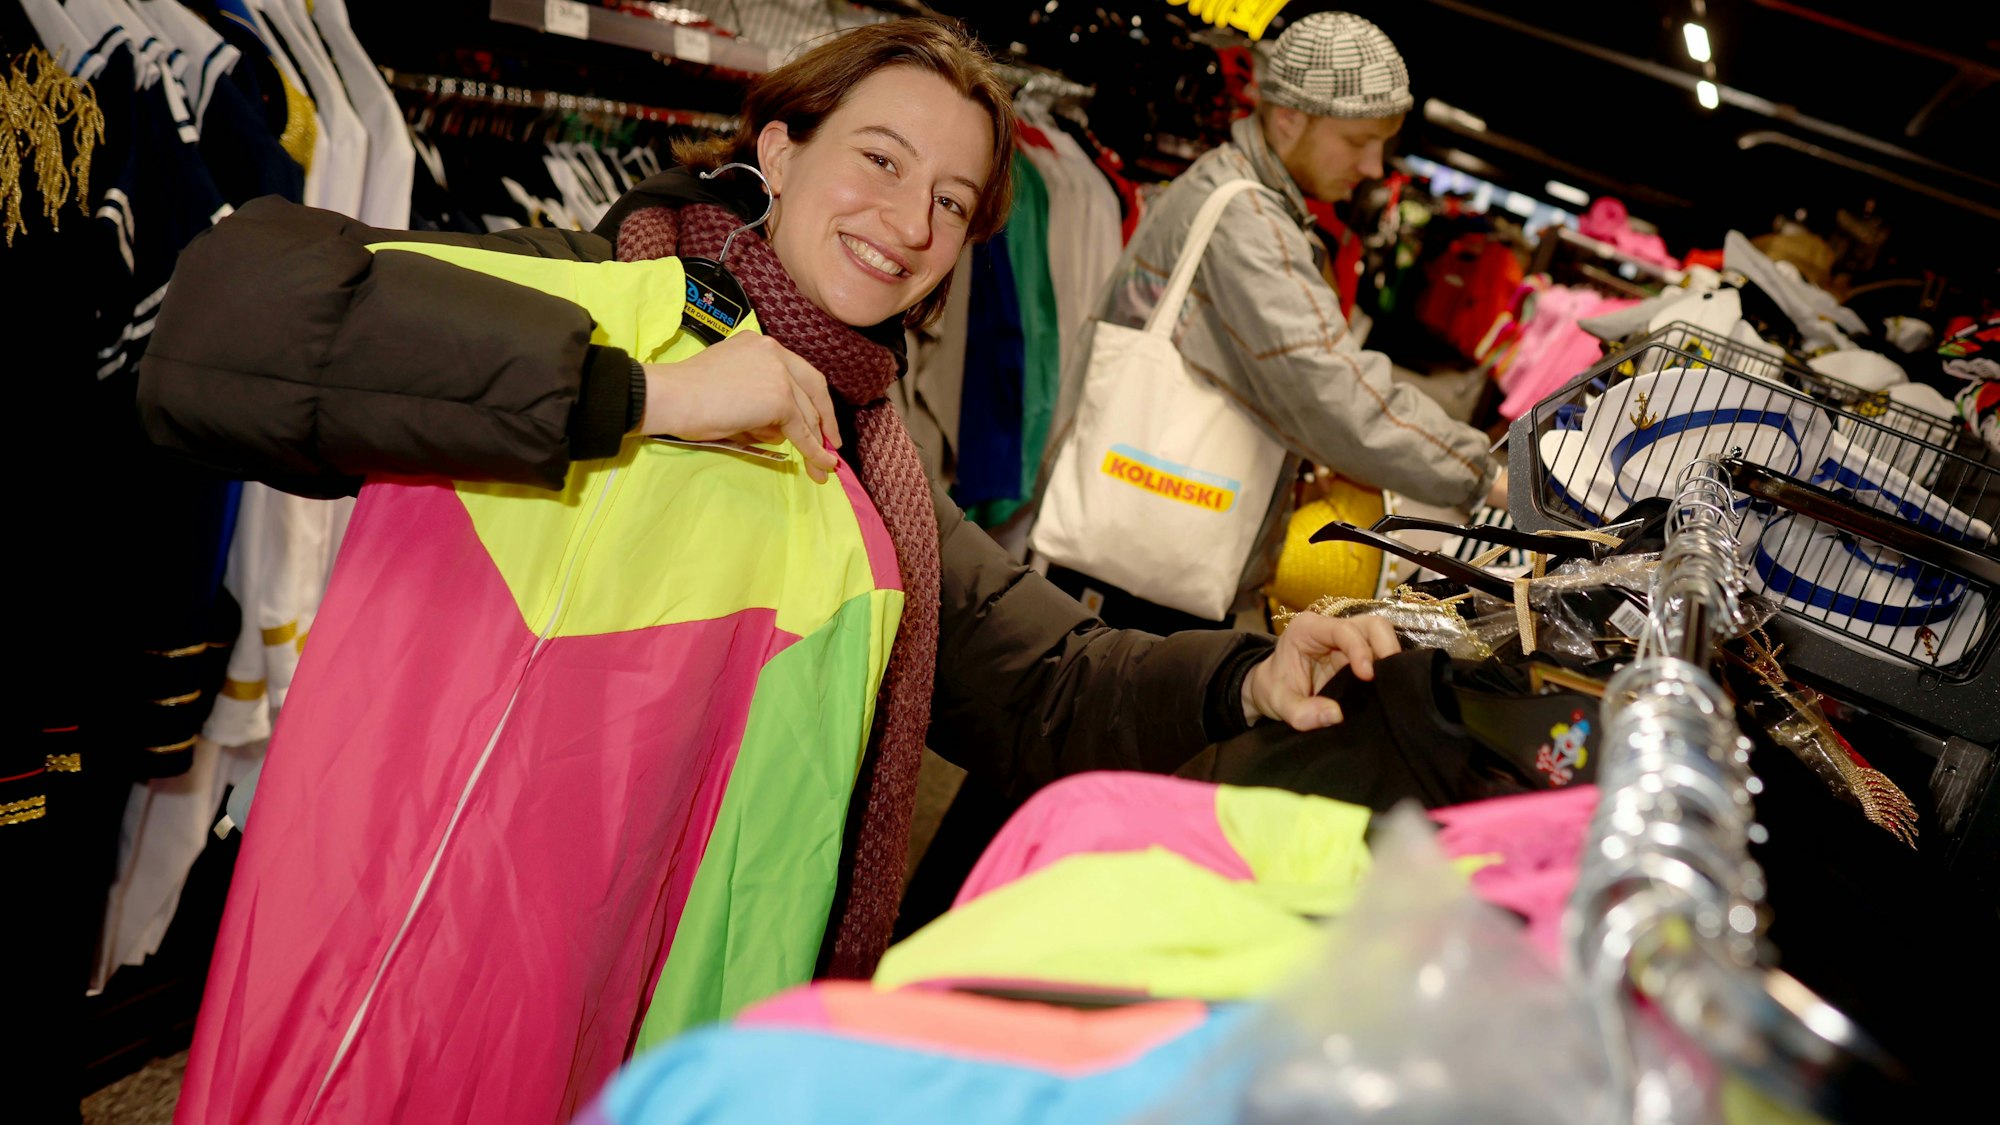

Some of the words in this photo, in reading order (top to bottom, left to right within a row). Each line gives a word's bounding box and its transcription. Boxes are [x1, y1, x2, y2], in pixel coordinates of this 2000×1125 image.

[696, 312, 707, 321] DU
[707, 316, 730, 334] WILLST
[1109, 457, 1224, 509] KOLINSKI
